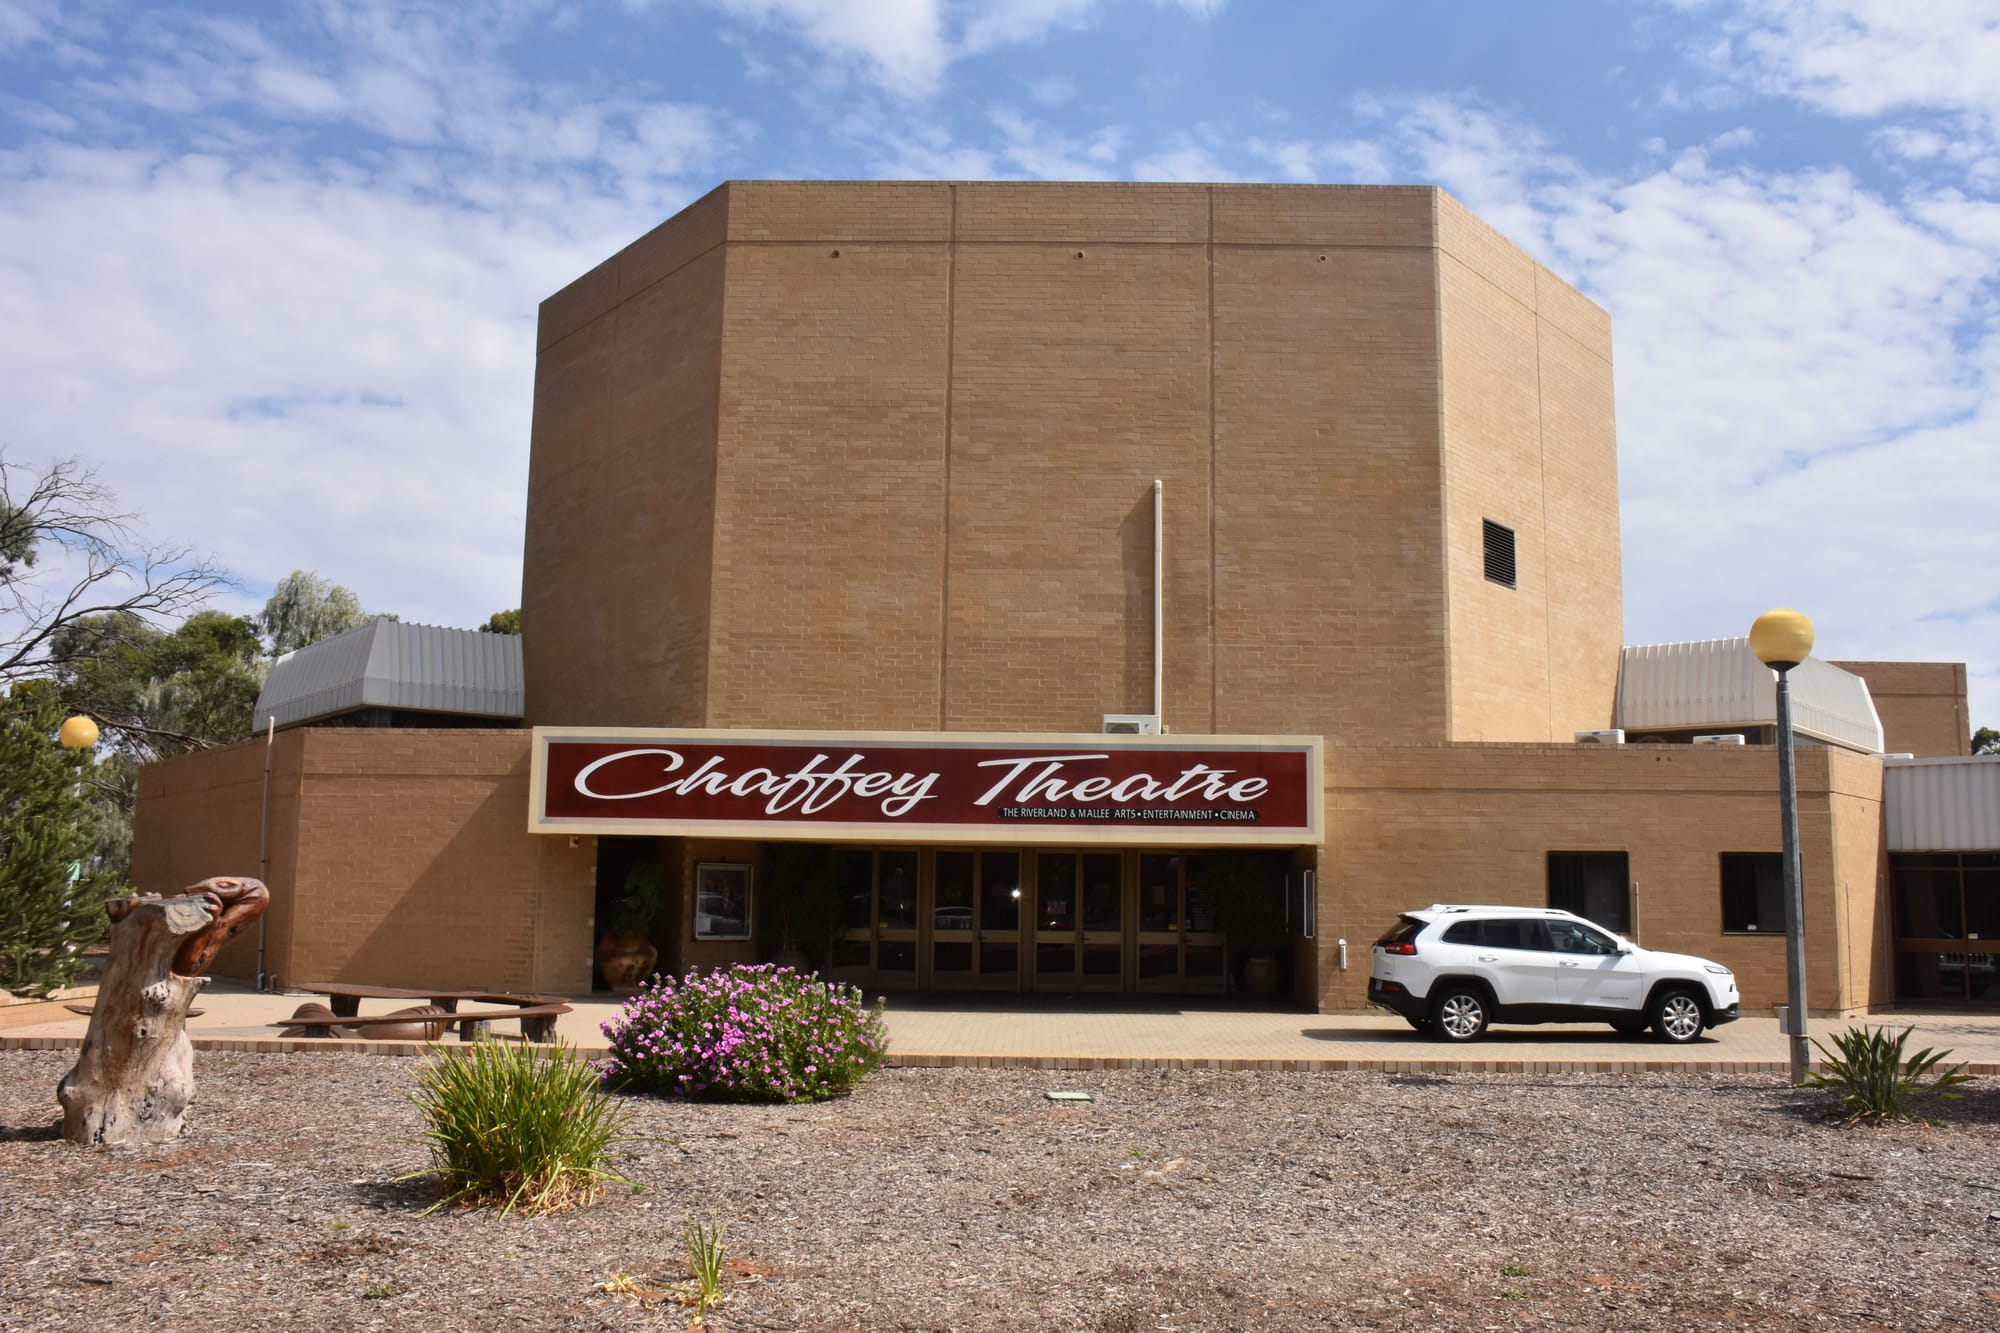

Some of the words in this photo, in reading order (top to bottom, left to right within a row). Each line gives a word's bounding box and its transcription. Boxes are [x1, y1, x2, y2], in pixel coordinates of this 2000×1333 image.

[574, 748, 941, 817] Chaffey
[973, 754, 1269, 806] Theatre
[1003, 808, 1019, 817] THE
[1021, 808, 1068, 818] RIVERLAND
[1069, 809, 1076, 818] &
[1079, 809, 1110, 818] MALLEE
[1113, 809, 1136, 819] ARTS
[1143, 810, 1213, 820] ENTERTAINMENT
[1220, 811, 1255, 820] CINEMA
